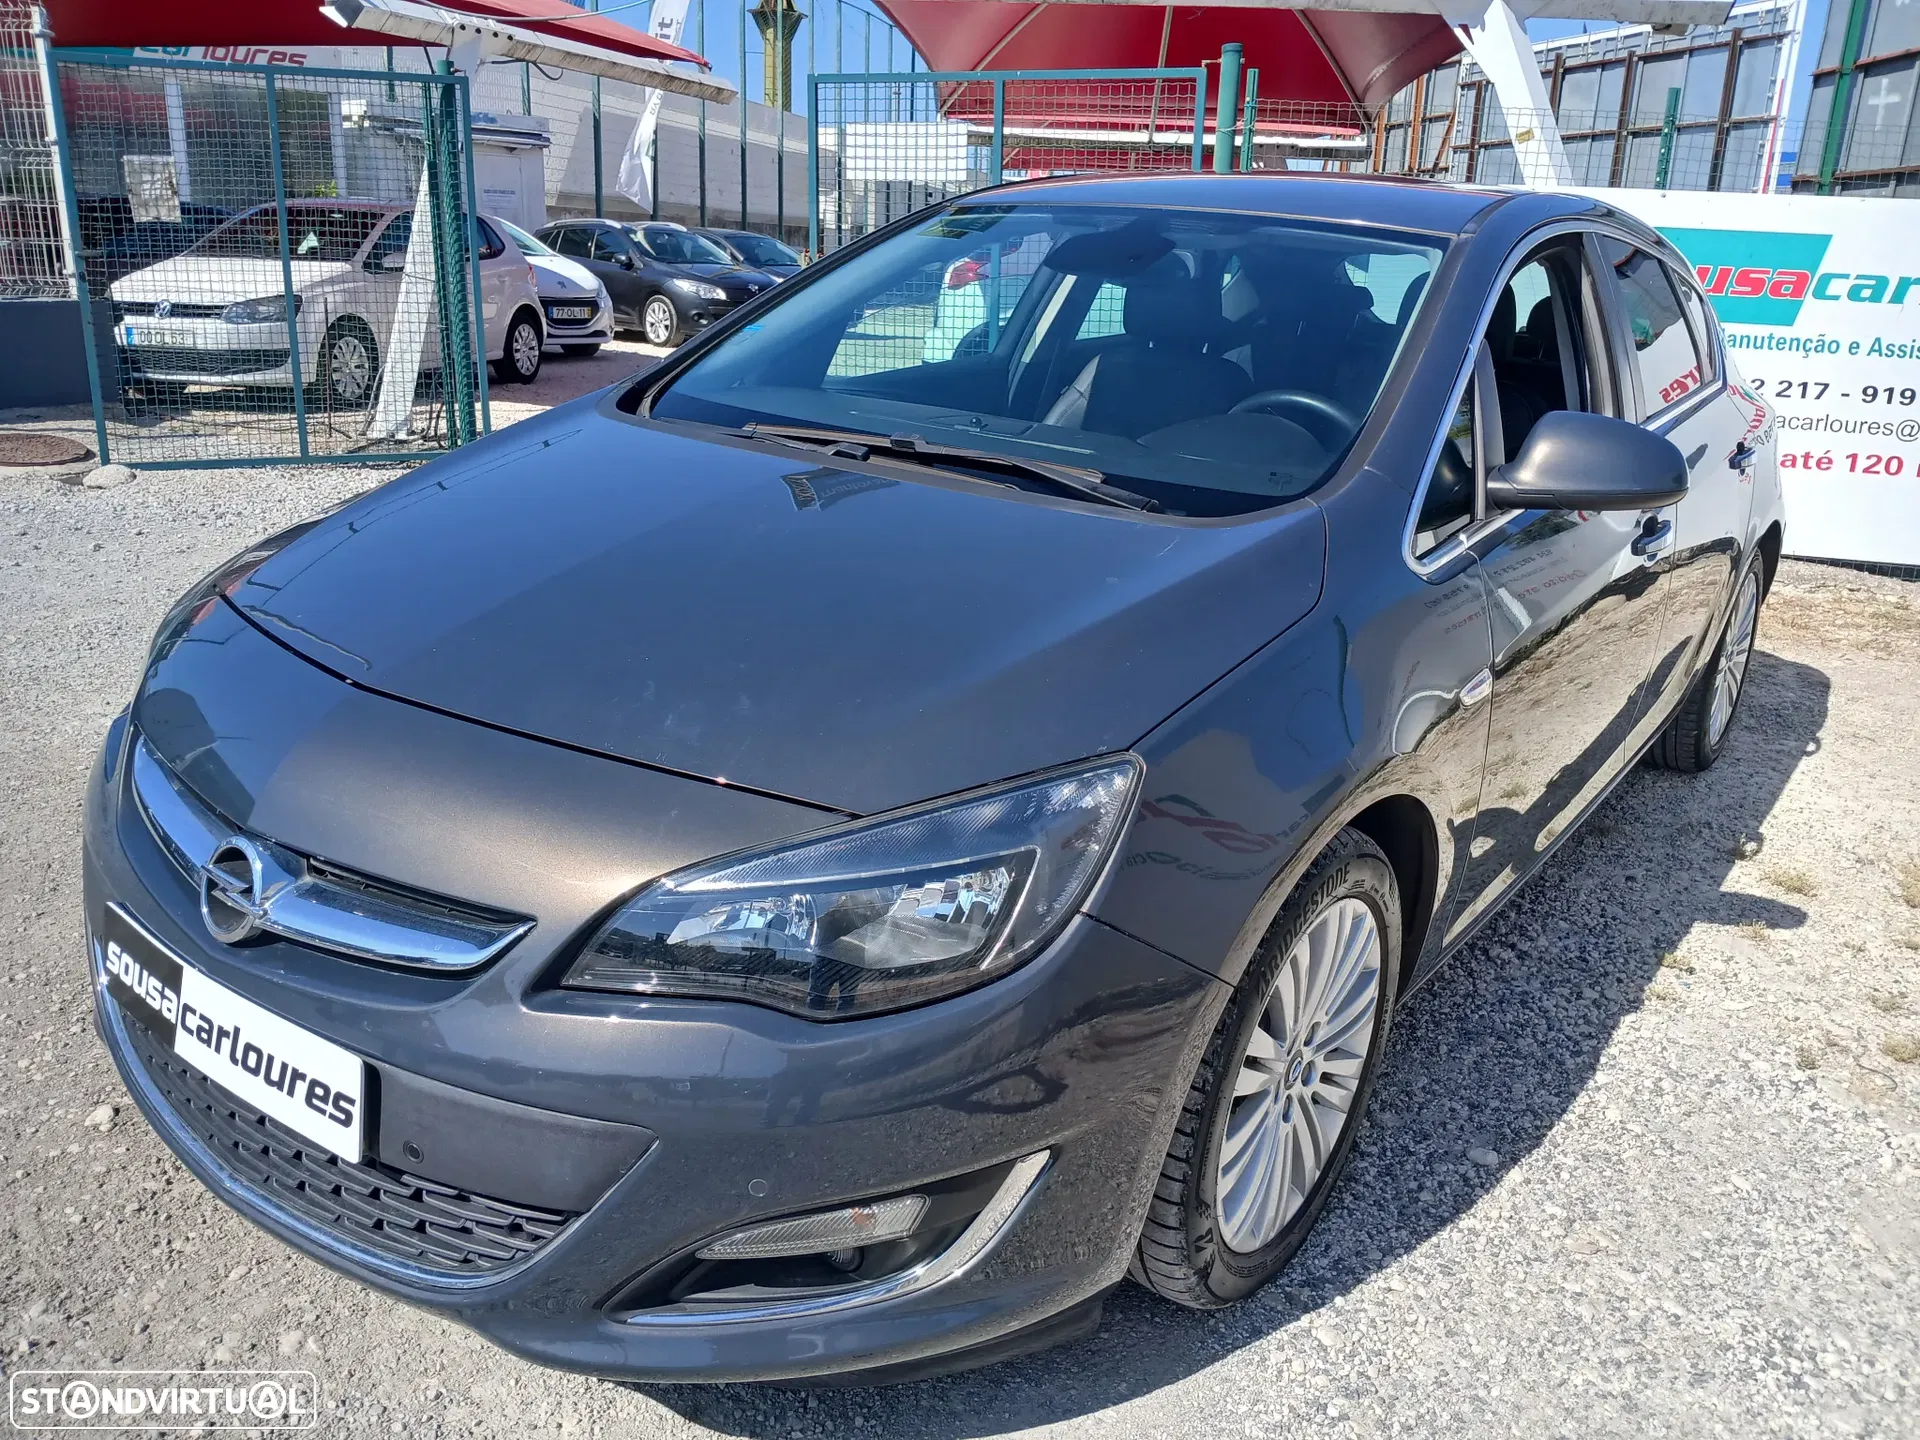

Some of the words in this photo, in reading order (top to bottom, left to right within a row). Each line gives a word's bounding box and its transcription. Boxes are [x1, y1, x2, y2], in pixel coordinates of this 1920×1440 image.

[1722, 328, 1840, 358] anutenção
[1849, 340, 1860, 355] e
[1775, 379, 1830, 400] 217
[1861, 385, 1916, 406] 919
[1780, 450, 1834, 471] até
[1845, 452, 1904, 476] 120
